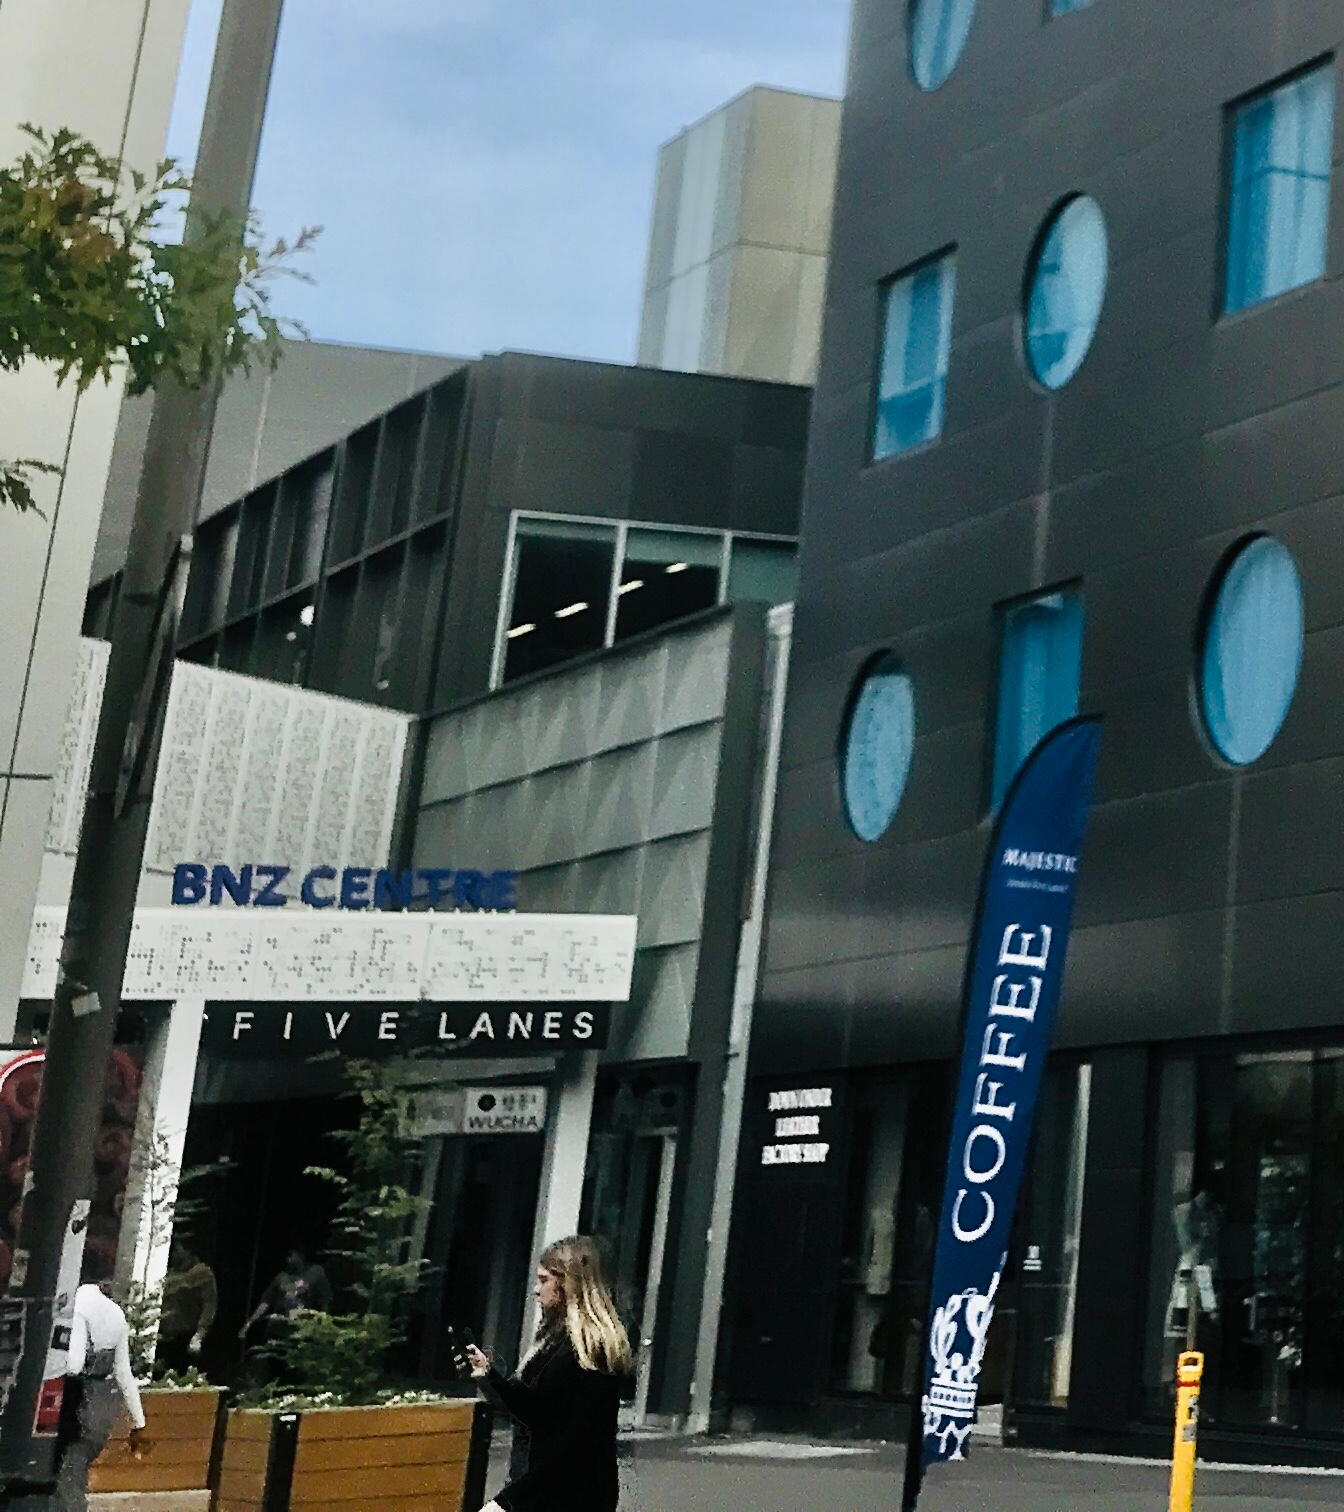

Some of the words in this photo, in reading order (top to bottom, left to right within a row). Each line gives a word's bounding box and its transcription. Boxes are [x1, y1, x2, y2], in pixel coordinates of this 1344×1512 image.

[171, 863, 292, 907] BNZ
[300, 865, 521, 910] CENTRE
[232, 1011, 400, 1041] FIVE
[438, 1010, 595, 1041] LANES
[951, 923, 1053, 1243] COFFEE
